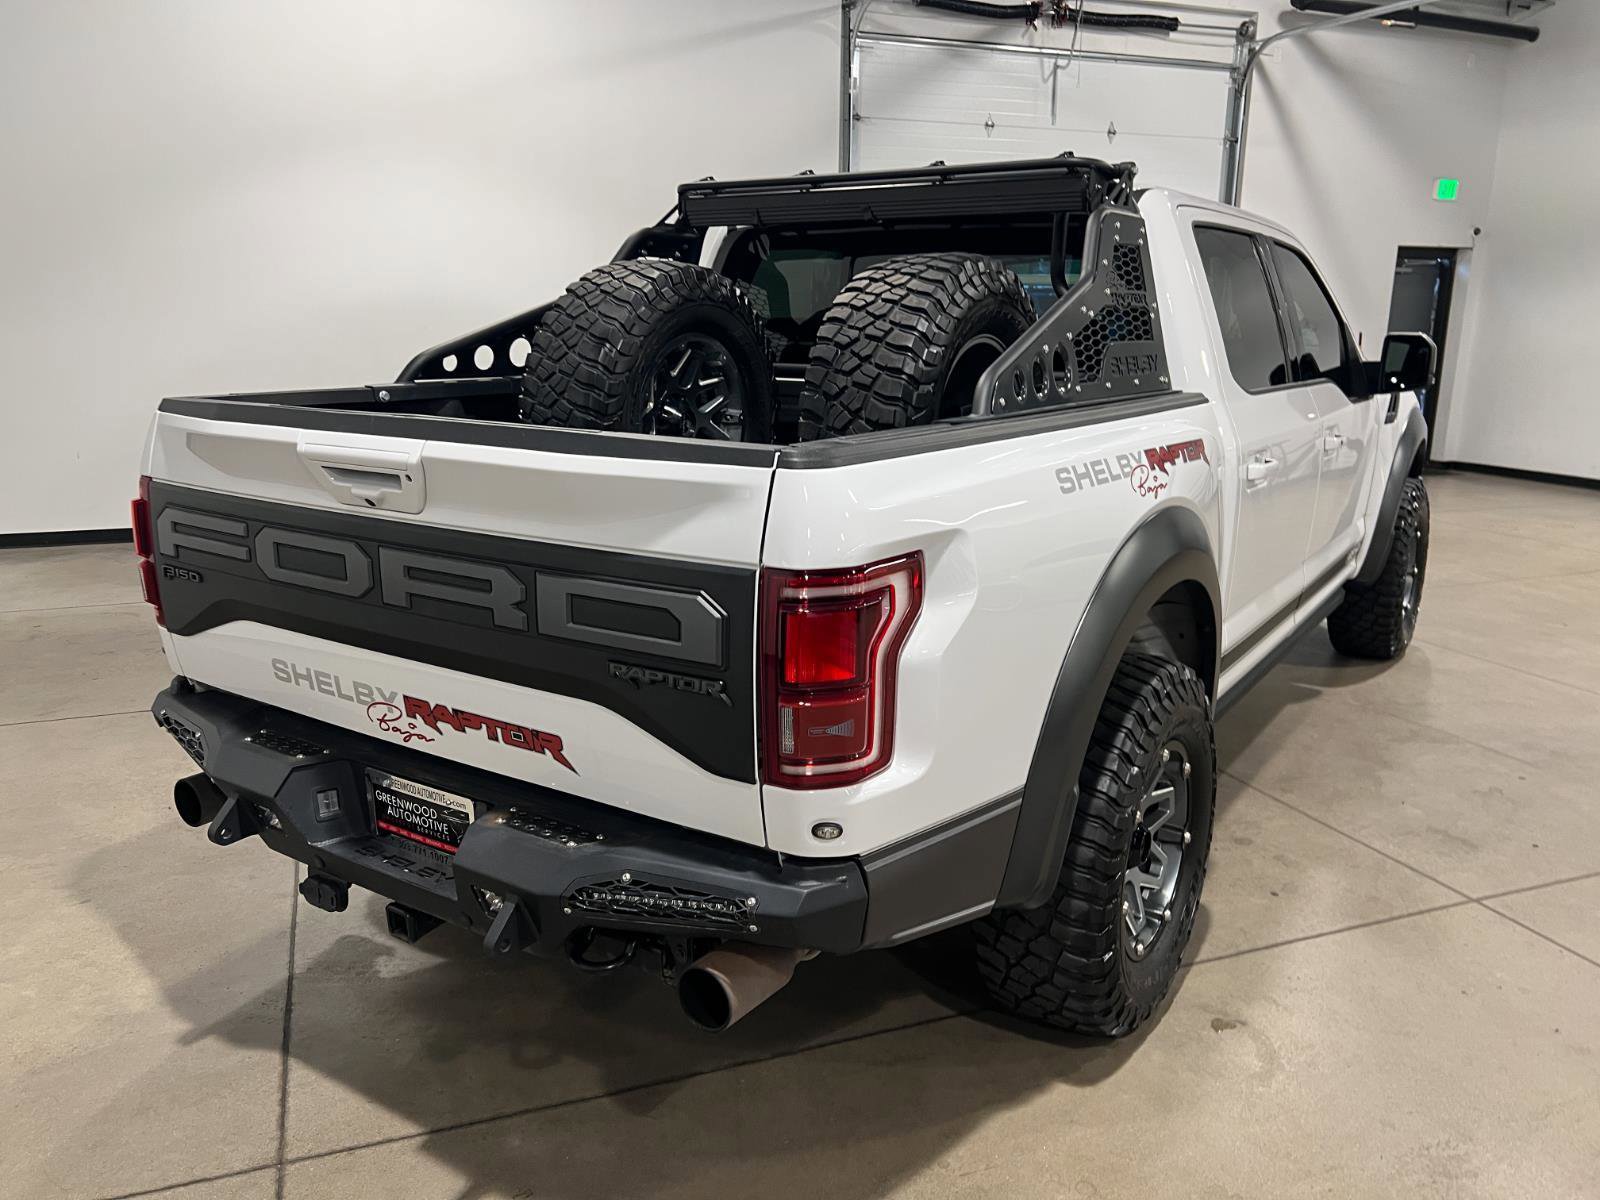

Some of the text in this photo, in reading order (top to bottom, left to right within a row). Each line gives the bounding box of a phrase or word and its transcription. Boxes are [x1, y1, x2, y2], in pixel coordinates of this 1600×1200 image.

[1111, 354, 1158, 377] SHELBY
[1055, 438, 1211, 495] SHELBY RAPTOR
[1130, 464, 1168, 499] Baja
[157, 507, 727, 668] FORD
[607, 660, 734, 707] RAPTOR
[271, 657, 581, 777] SHELBY RAPTOR
[367, 702, 435, 743] Baja
[375, 789, 437, 819] GREENWOOD
[387, 806, 449, 834] AUTOMOTIVE
